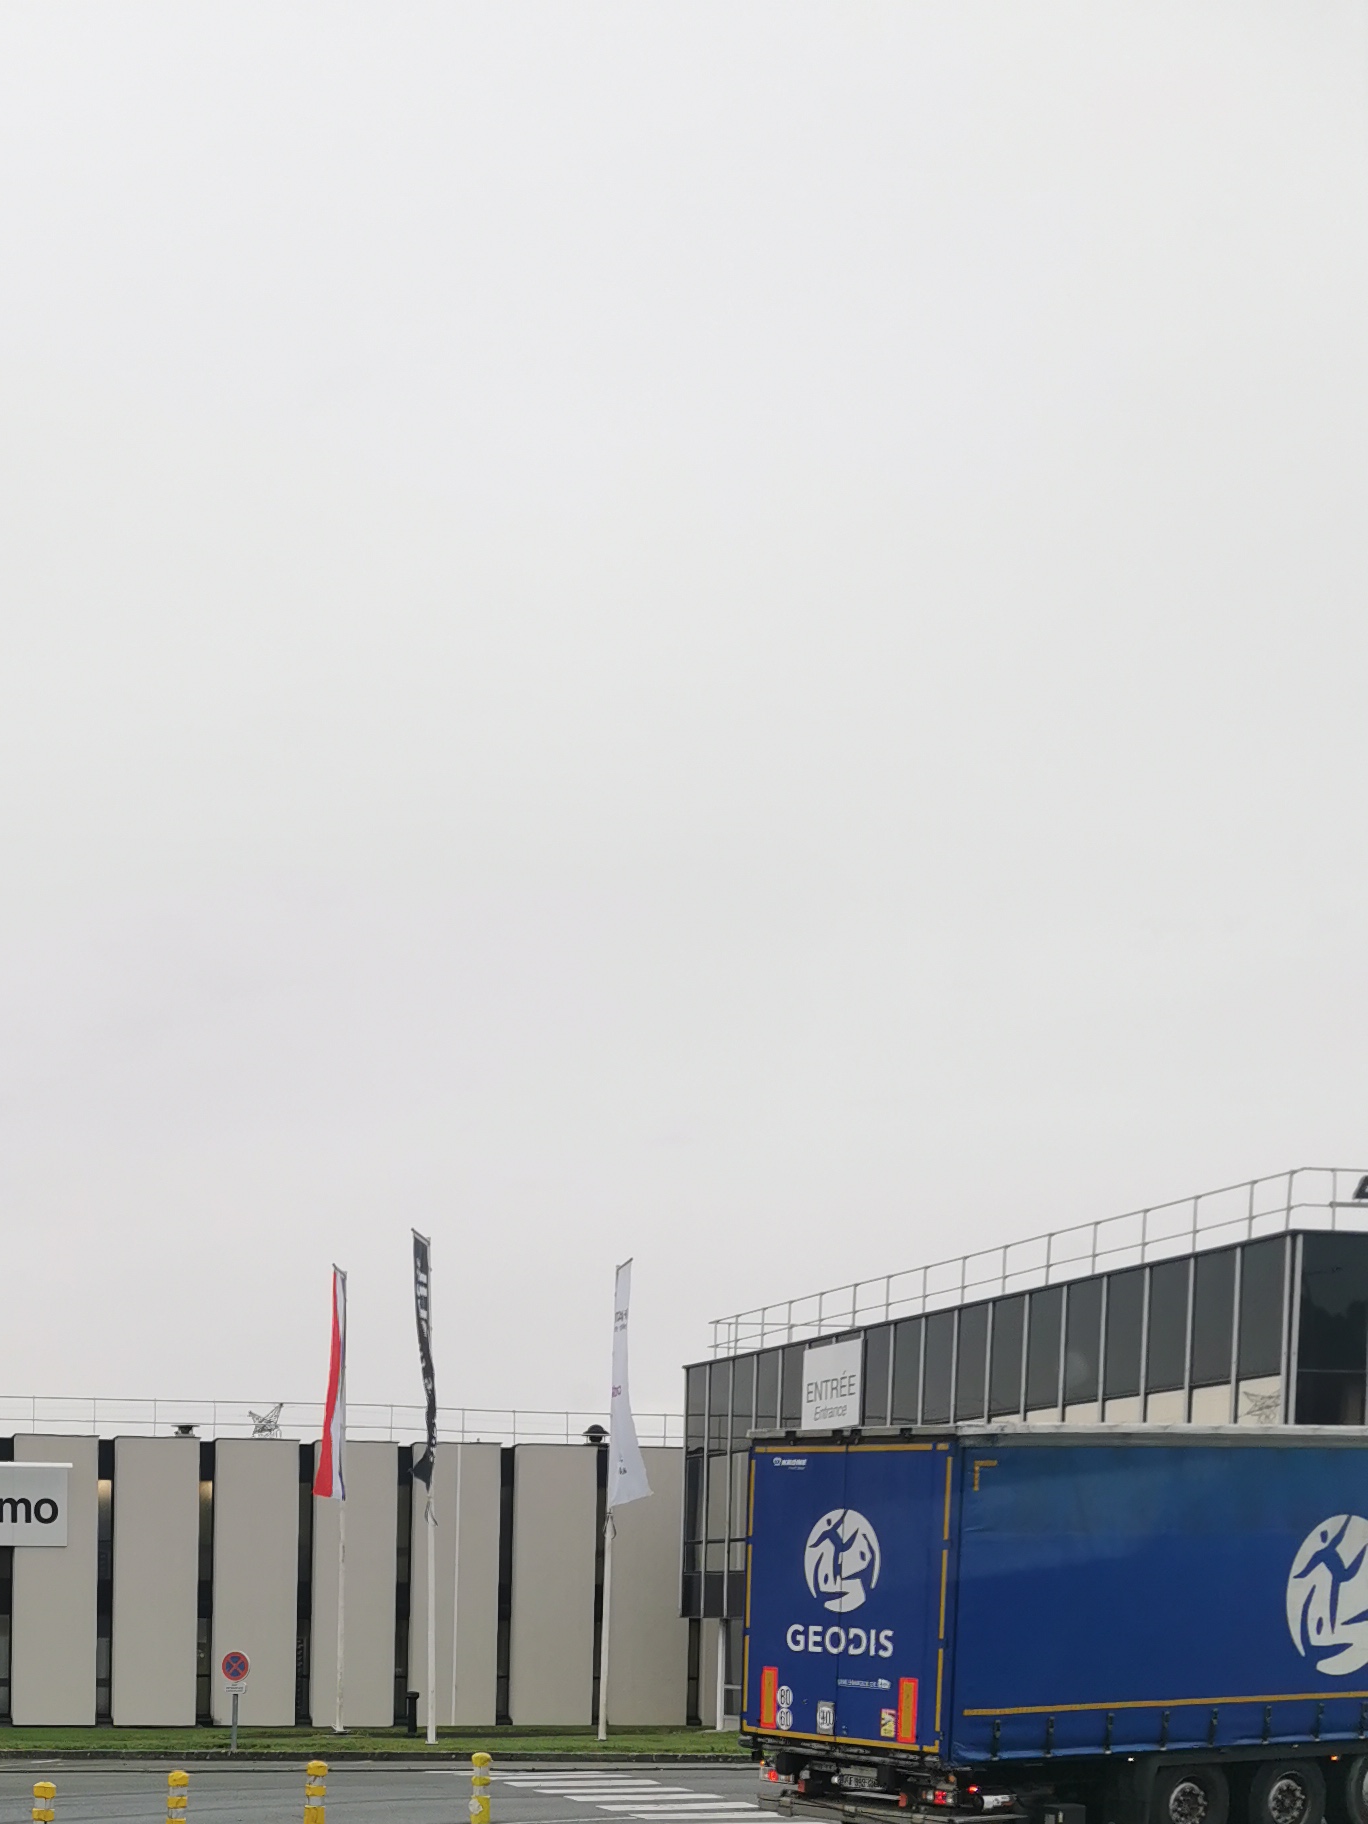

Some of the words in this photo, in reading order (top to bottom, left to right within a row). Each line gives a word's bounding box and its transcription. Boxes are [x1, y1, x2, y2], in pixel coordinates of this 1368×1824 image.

[806, 1370, 856, 1403] ENTRÉE
[814, 1405, 847, 1421] Entrance
[786, 1623, 895, 1659] GEODIS
[780, 1688, 791, 1705] 80
[780, 1710, 791, 1727] 60
